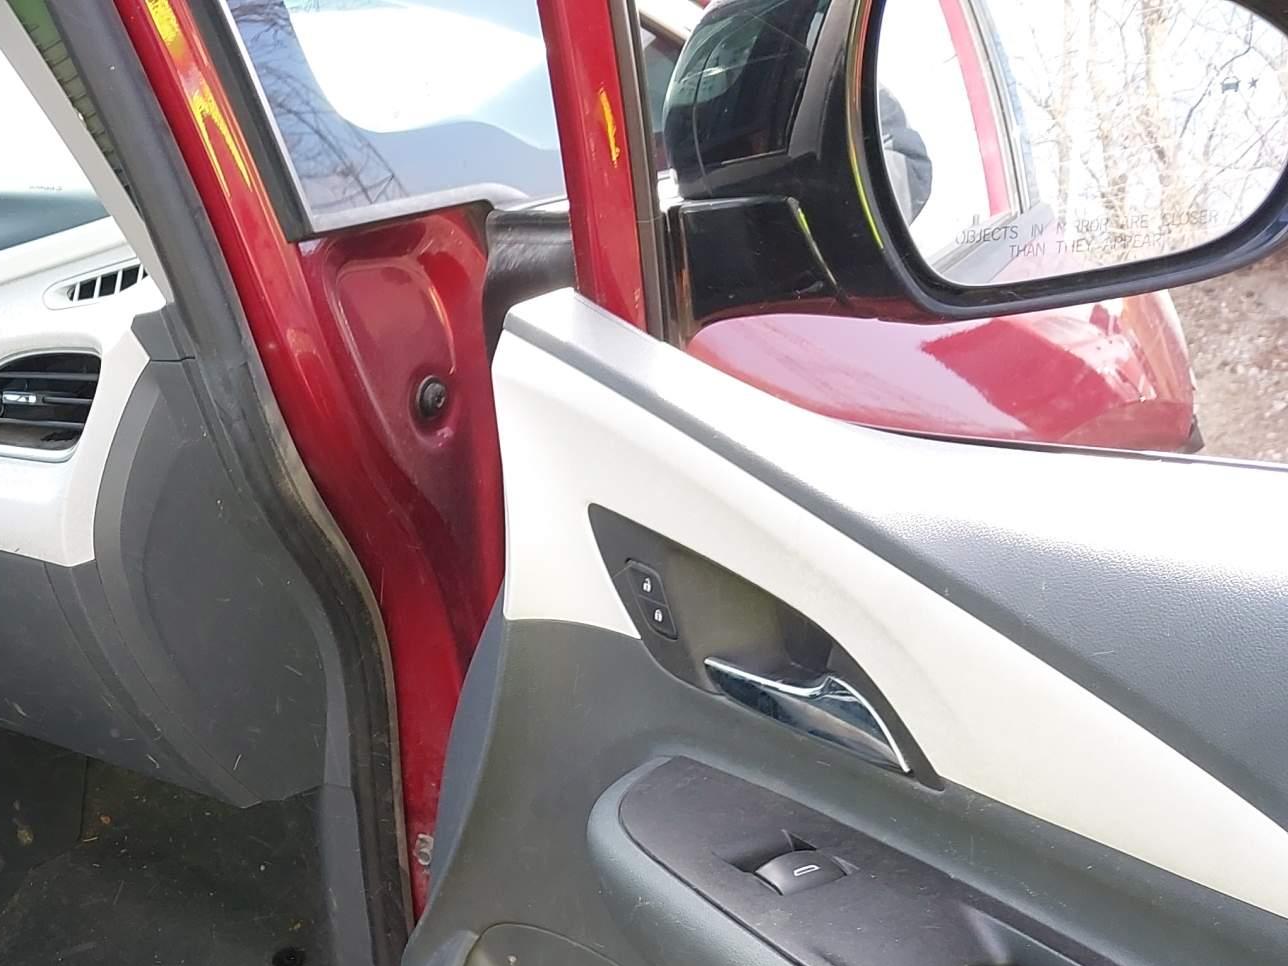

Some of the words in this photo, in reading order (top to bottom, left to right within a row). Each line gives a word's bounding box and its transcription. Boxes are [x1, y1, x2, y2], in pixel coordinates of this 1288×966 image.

[955, 225, 1019, 245] OBJECTS
[1031, 223, 1044, 238] IN
[1056, 217, 1109, 233] MRROR
[1163, 209, 1218, 226] CLOSER
[1008, 242, 1045, 257] THAN
[1056, 239, 1092, 254] THEY
[1103, 233, 1162, 252] APPEAR
